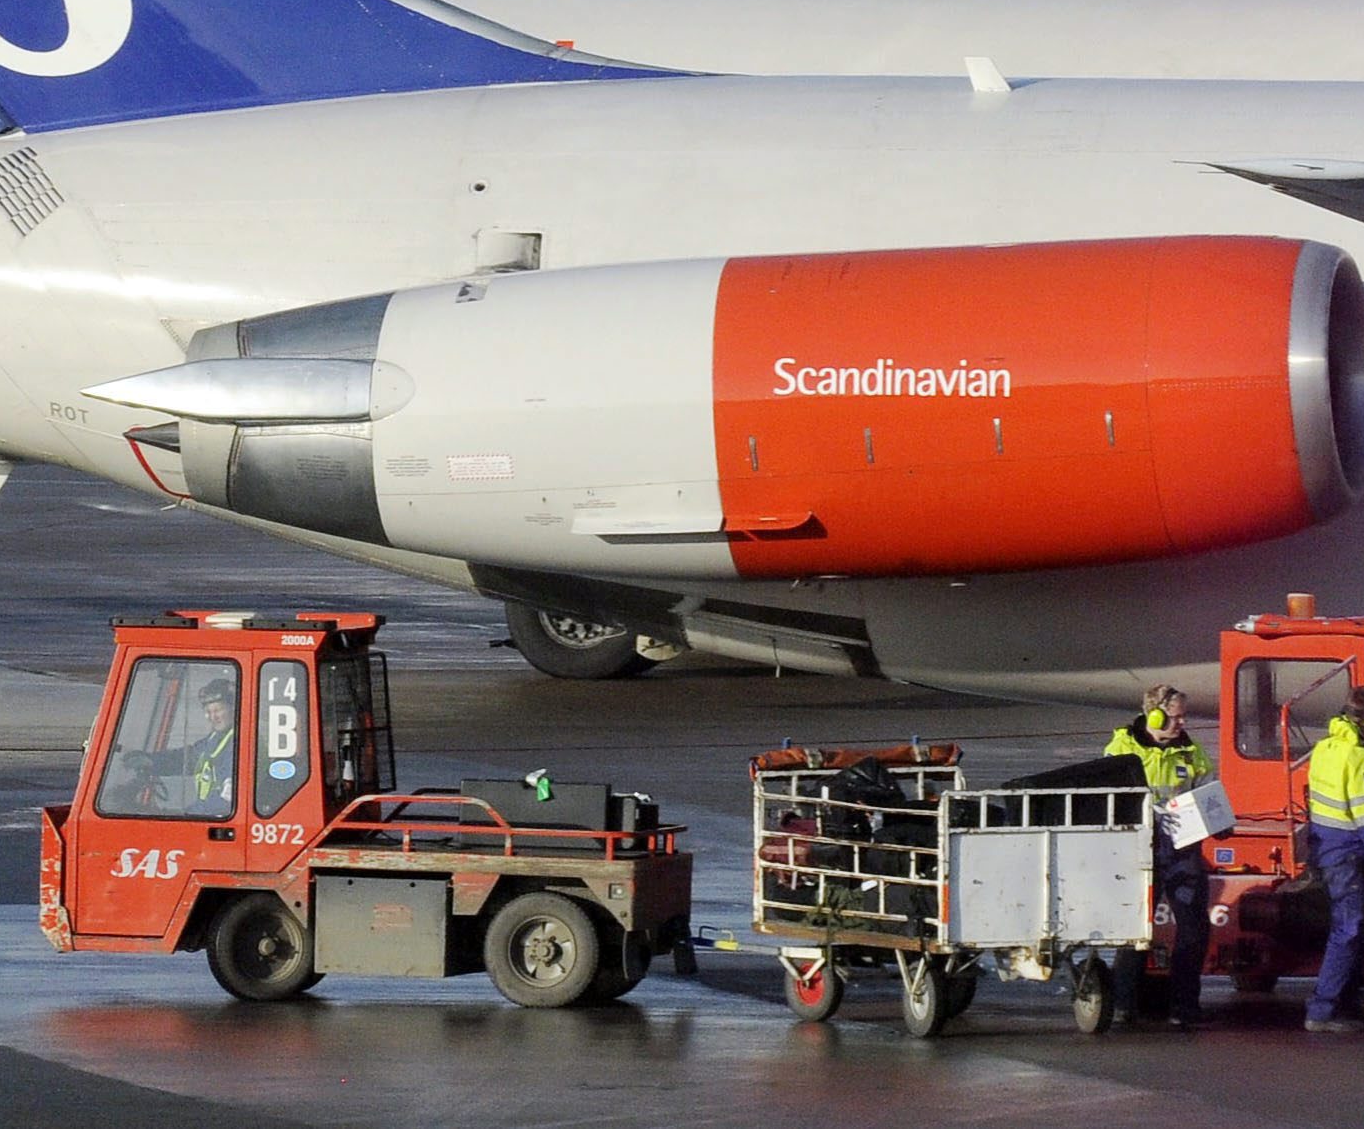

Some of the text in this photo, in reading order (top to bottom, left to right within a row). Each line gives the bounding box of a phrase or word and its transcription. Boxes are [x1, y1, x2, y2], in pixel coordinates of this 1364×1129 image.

[773, 357, 1012, 397] Scandinavian
[49, 401, 90, 424] ROT
[267, 704, 298, 759] B
[250, 822, 305, 846] 9872
[110, 847, 186, 880] SAS
